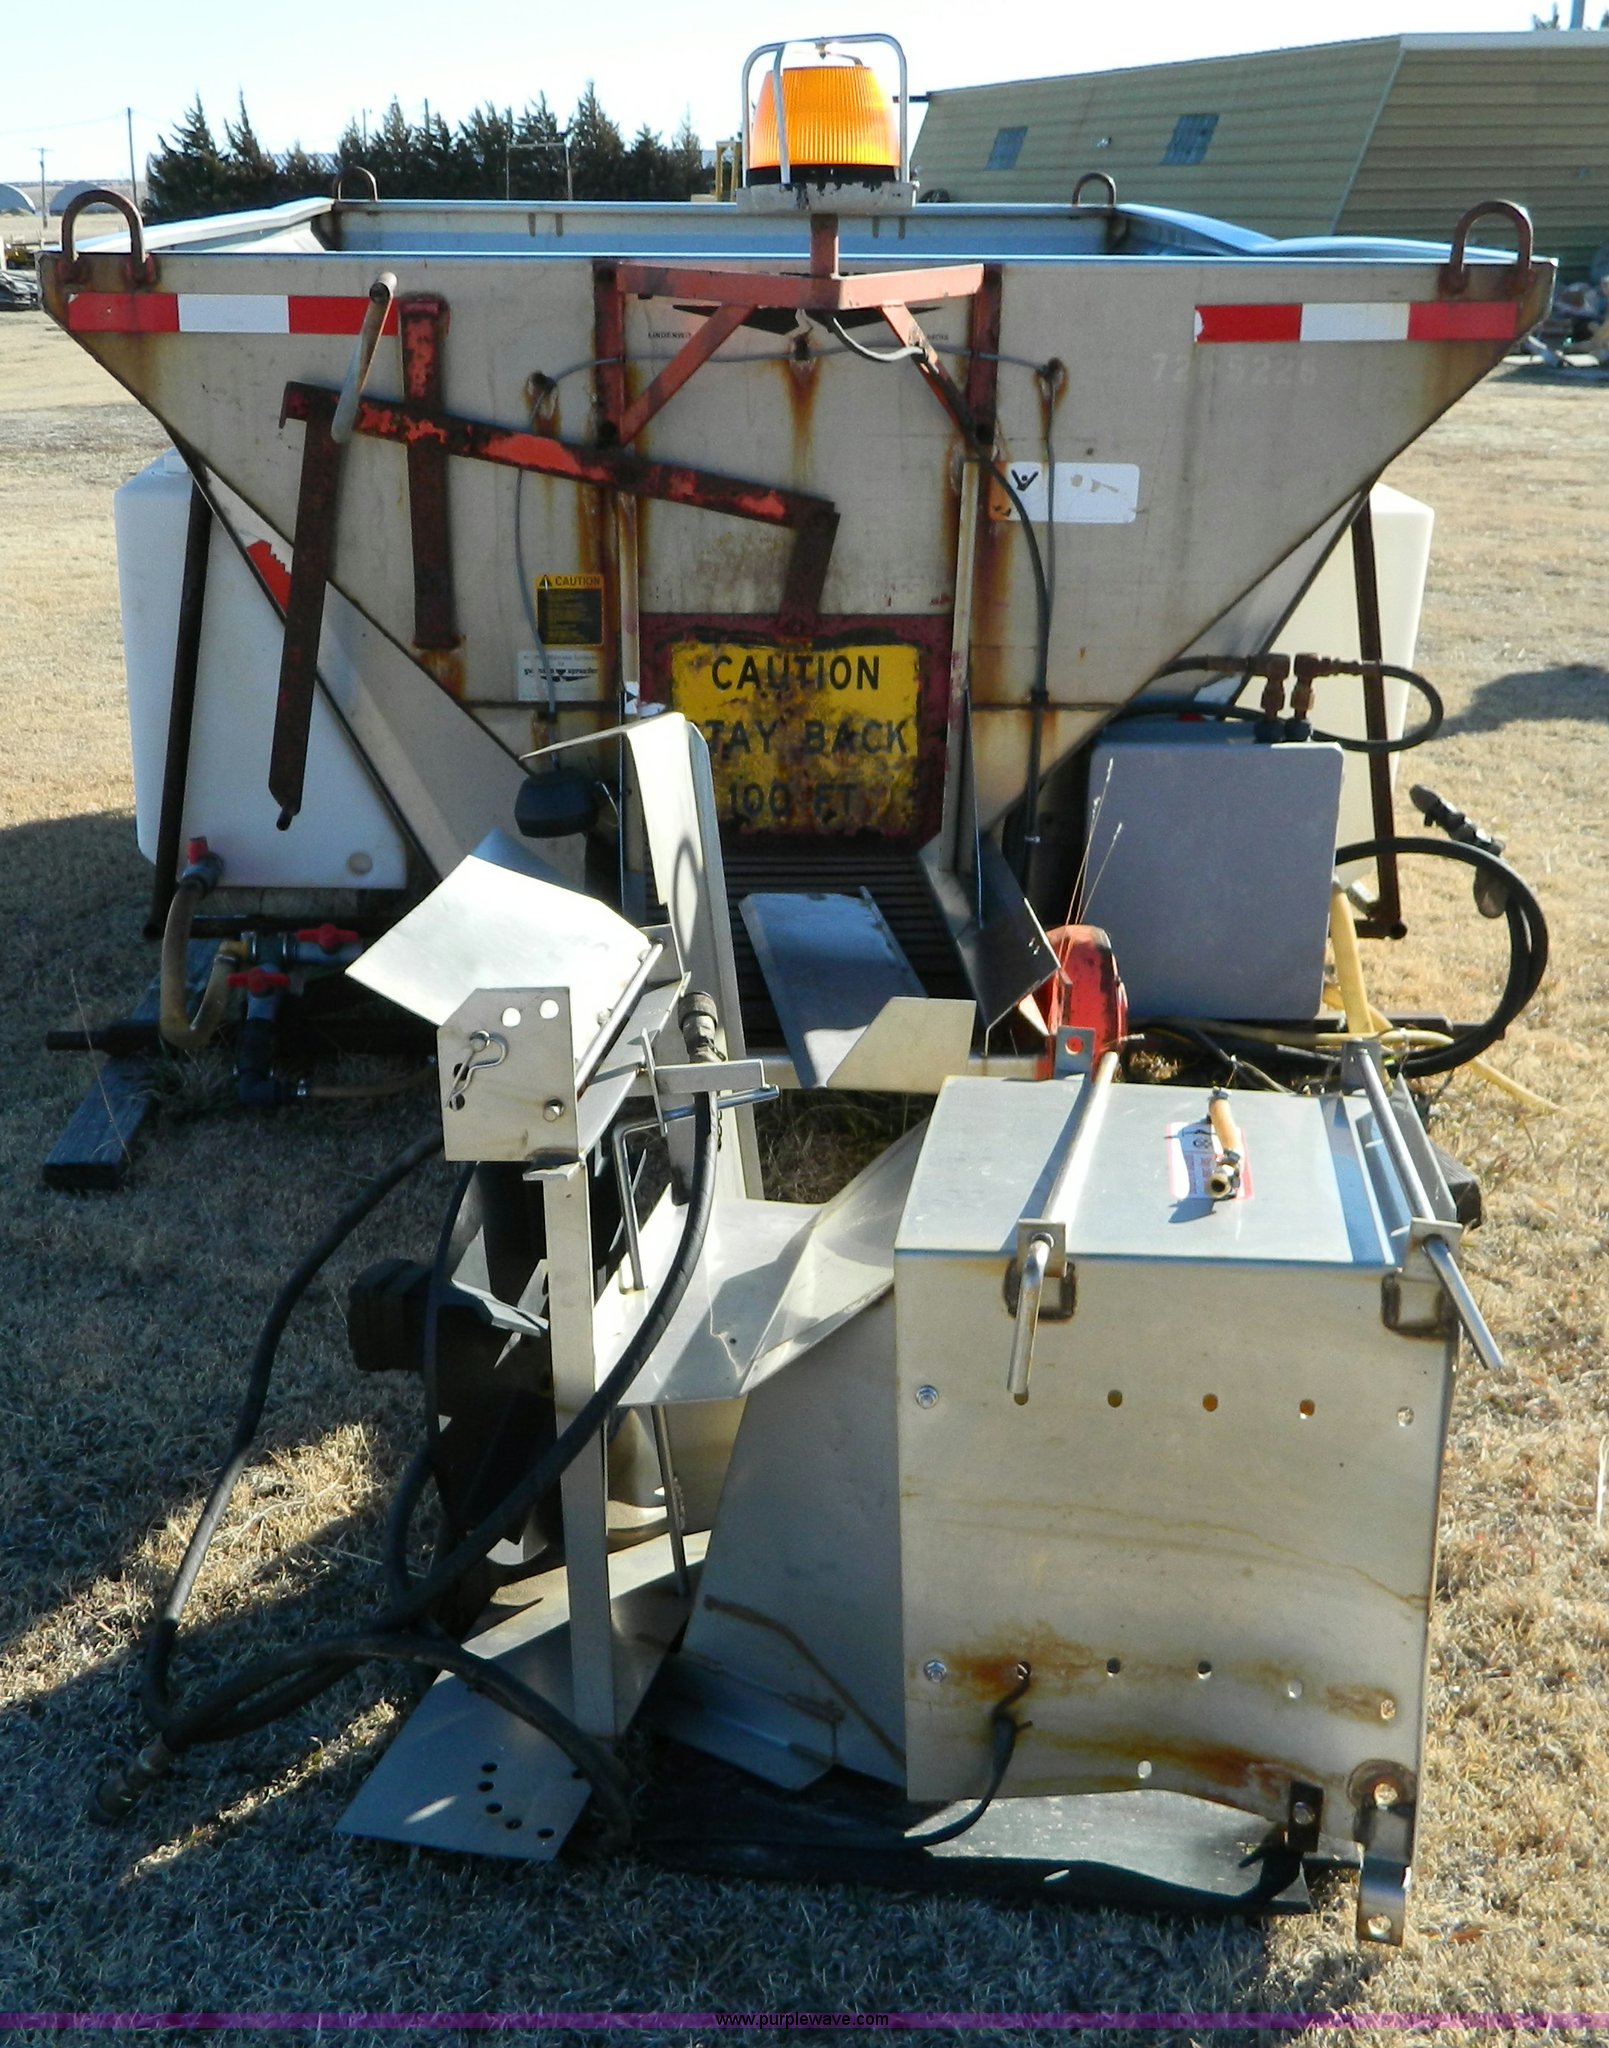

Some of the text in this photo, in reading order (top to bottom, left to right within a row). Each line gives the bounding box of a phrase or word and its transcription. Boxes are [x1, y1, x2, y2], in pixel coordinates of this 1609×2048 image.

[555, 575, 601, 586] CAUTION
[711, 655, 880, 691] CAUTION
[692, 716, 909, 754] TAY BACK
[728, 781, 858, 818] 100 FT
